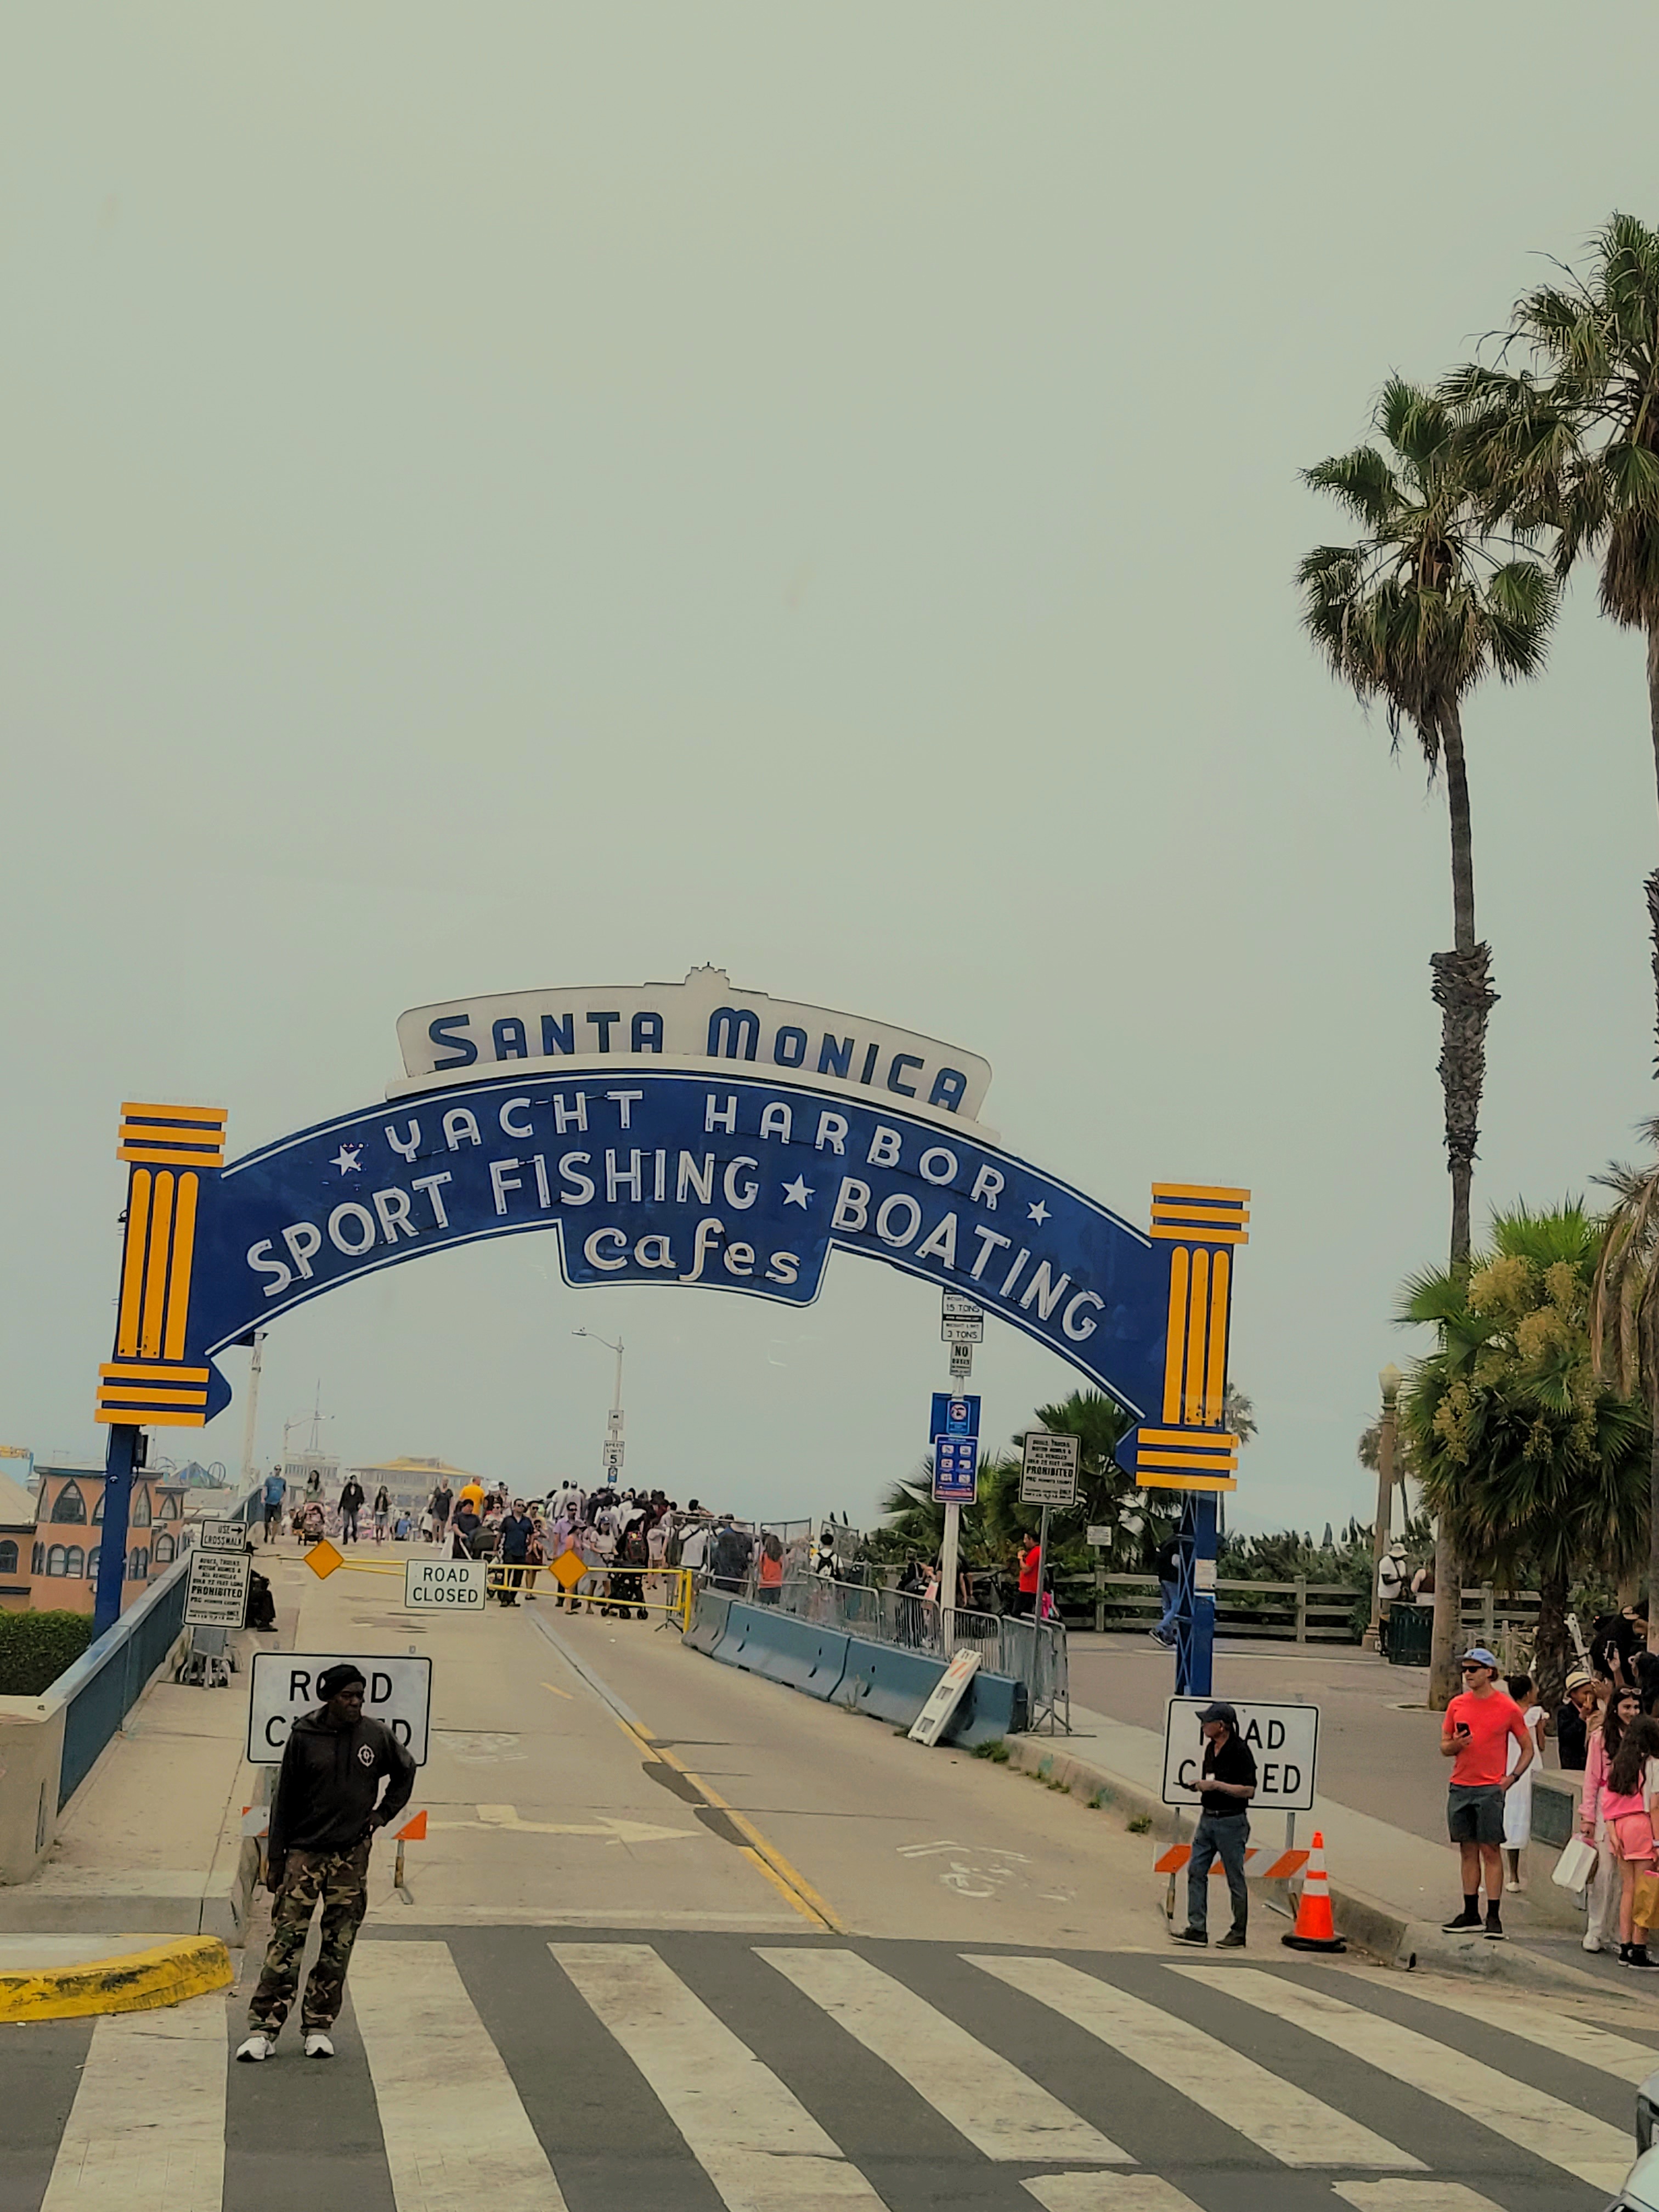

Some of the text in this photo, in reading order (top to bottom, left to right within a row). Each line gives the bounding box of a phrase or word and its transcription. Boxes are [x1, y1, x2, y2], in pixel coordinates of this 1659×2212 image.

[428, 1007, 967, 1113] SANTA MONICA
[384, 1091, 1006, 1210] YACHT HARBOR
[246, 1149, 1106, 1342] SPORT FISHING BOATING
[958, 1305, 979, 1313] TONS
[956, 1330, 978, 1339] TONS
[955, 1345, 968, 1357] NO
[610, 1455, 617, 1464] 5
[1026, 1466, 1074, 1477] PROHIBITED
[218, 1526, 230, 1534] USE
[204, 1534, 242, 1545] CROSSWALK
[424, 1567, 469, 1583] ROAD
[191, 1585, 243, 1598] PROHIBITED
[413, 1587, 478, 1603] CLOSED
[290, 1670, 392, 1703] RD
[1200, 1719, 1285, 1750] AD
[1178, 1759, 1301, 1794] CED
